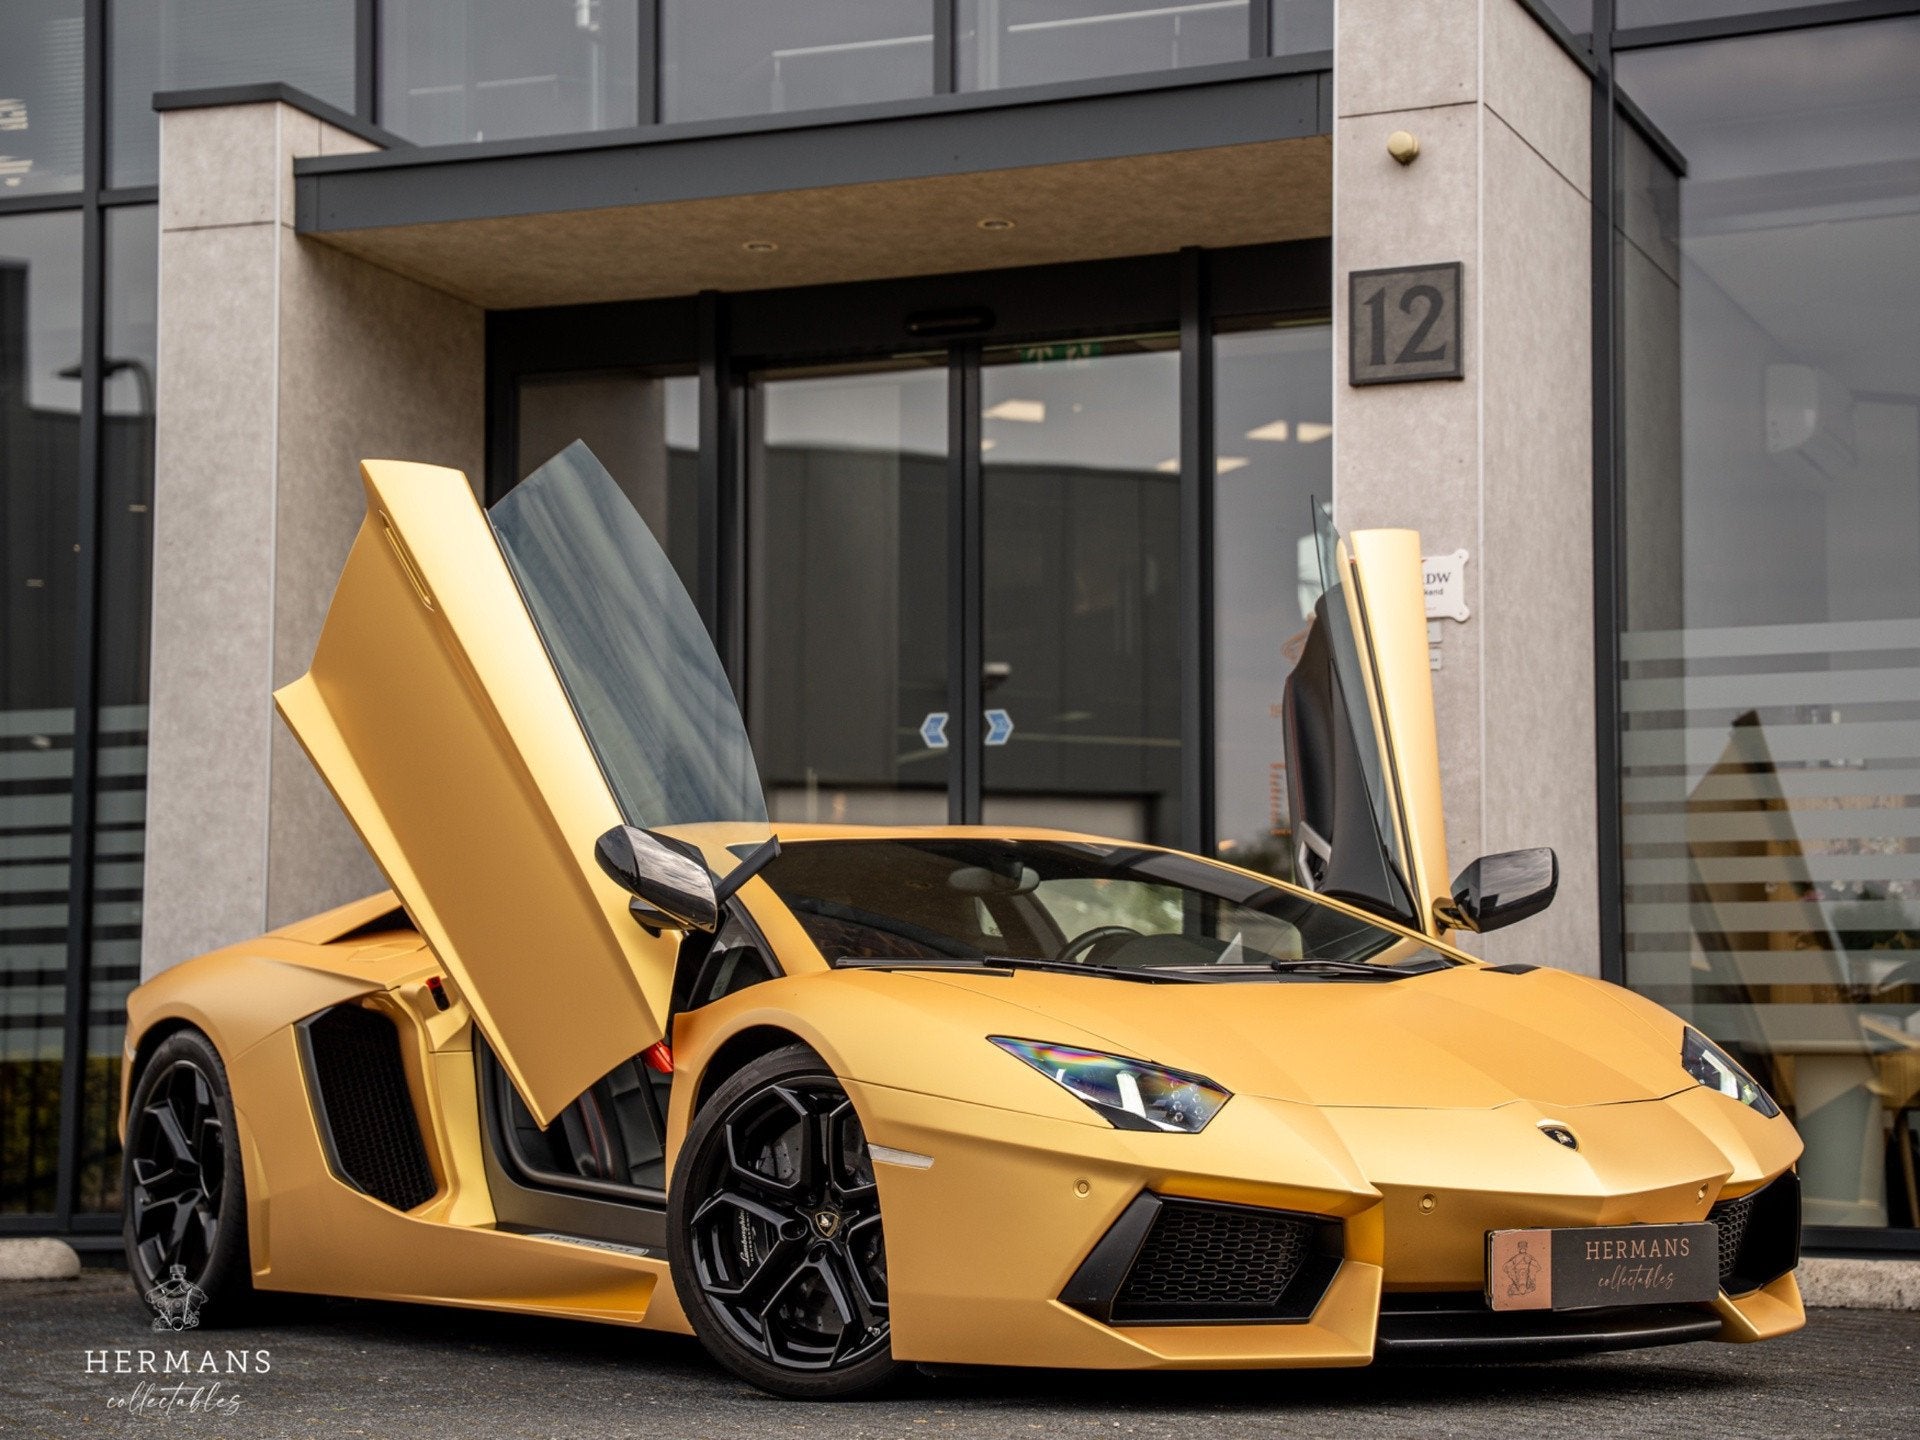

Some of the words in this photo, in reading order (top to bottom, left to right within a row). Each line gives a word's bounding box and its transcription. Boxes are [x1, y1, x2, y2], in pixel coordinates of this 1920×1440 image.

[1363, 285, 1448, 366] 12
[1423, 572, 1451, 584] DW
[1585, 1237, 1690, 1260] HERMANS
[1598, 1264, 1675, 1292] collectables
